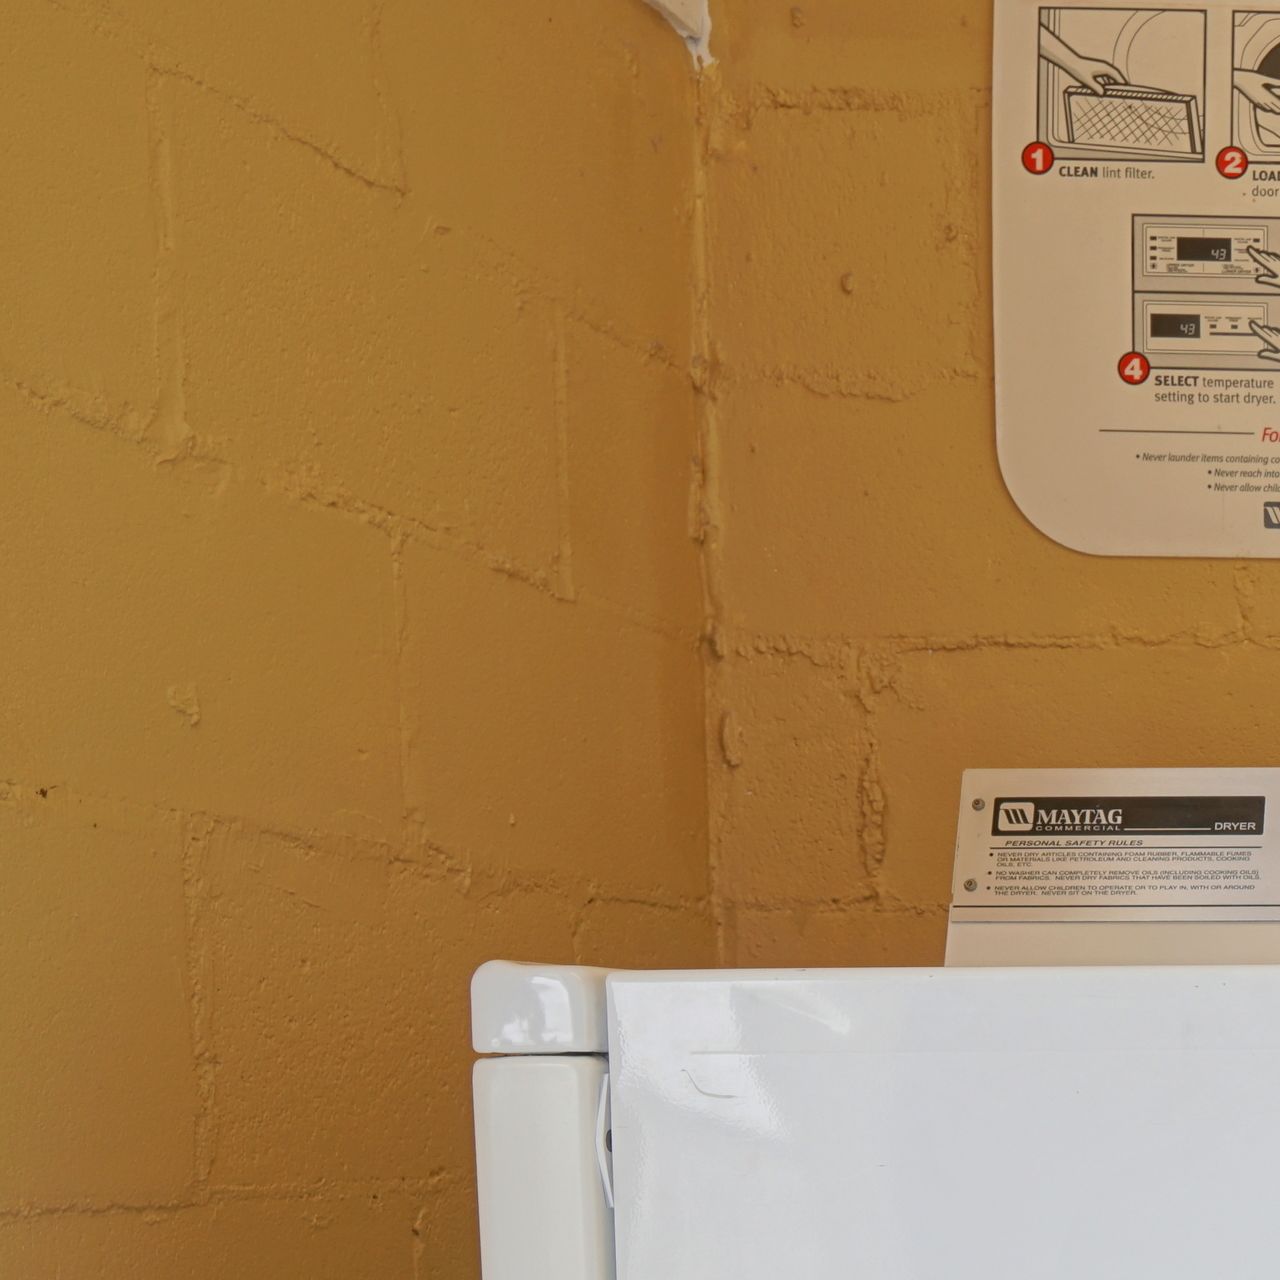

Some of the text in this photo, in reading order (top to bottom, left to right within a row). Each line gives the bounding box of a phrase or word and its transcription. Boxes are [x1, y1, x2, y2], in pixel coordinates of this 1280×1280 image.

[1031, 148, 1155, 179] 1 CLEAN lint filter.
[1223, 151, 1242, 174] 2
[1251, 186, 1279, 198] door
[1211, 249, 1227, 260] 43
[1179, 323, 1195, 335] 43
[1124, 358, 1274, 390] 4 SELECT temperature
[1154, 390, 1276, 406] setting to start dryer.
[1142, 452, 1167, 462] Never
[1168, 453, 1200, 463] launder
[1201, 453, 1224, 463] items
[1225, 454, 1268, 465] containing
[1214, 468, 1238, 477] Never
[1239, 469, 1262, 478] reach
[1264, 469, 1280, 478] into
[1214, 482, 1238, 492] Never
[1239, 483, 1261, 492] allow
[1037, 808, 1123, 825] MAYTAG
[1214, 822, 1256, 830] DRYER
